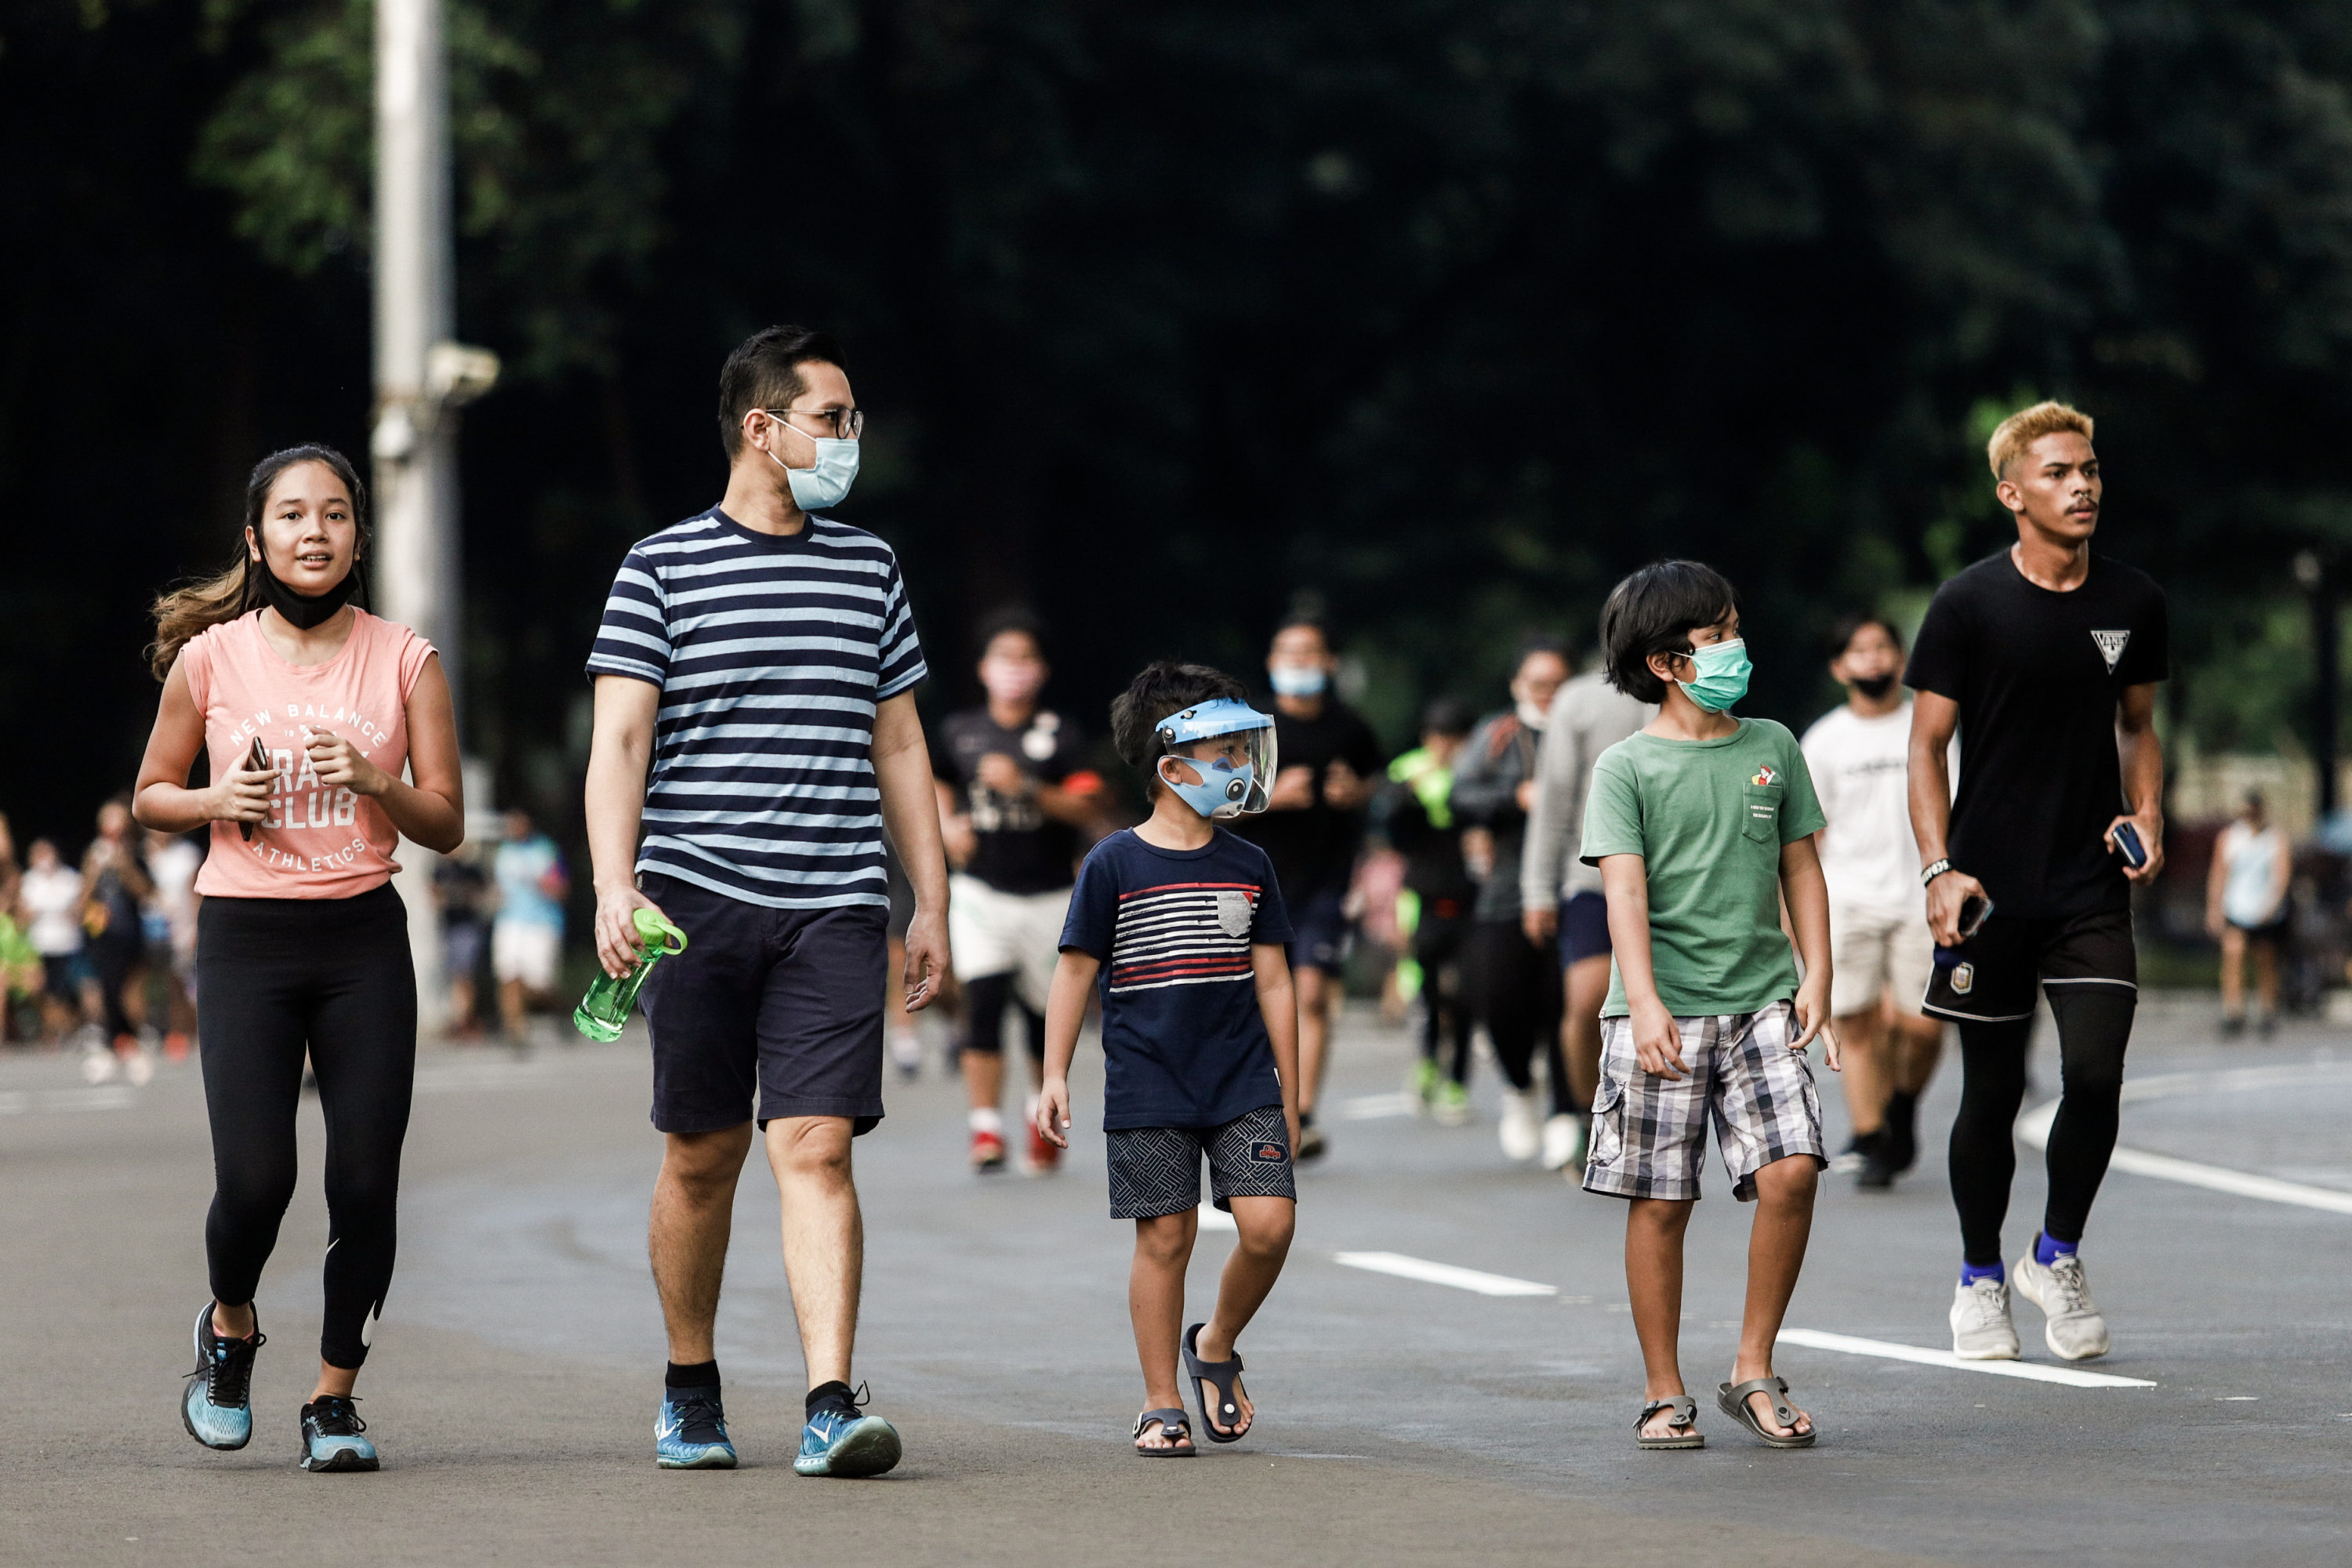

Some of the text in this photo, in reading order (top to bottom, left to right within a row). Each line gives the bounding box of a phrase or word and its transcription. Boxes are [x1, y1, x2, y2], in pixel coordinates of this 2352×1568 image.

[230, 704, 387, 748] NEW BALANCE
[252, 837, 366, 873] ATHLETICS
